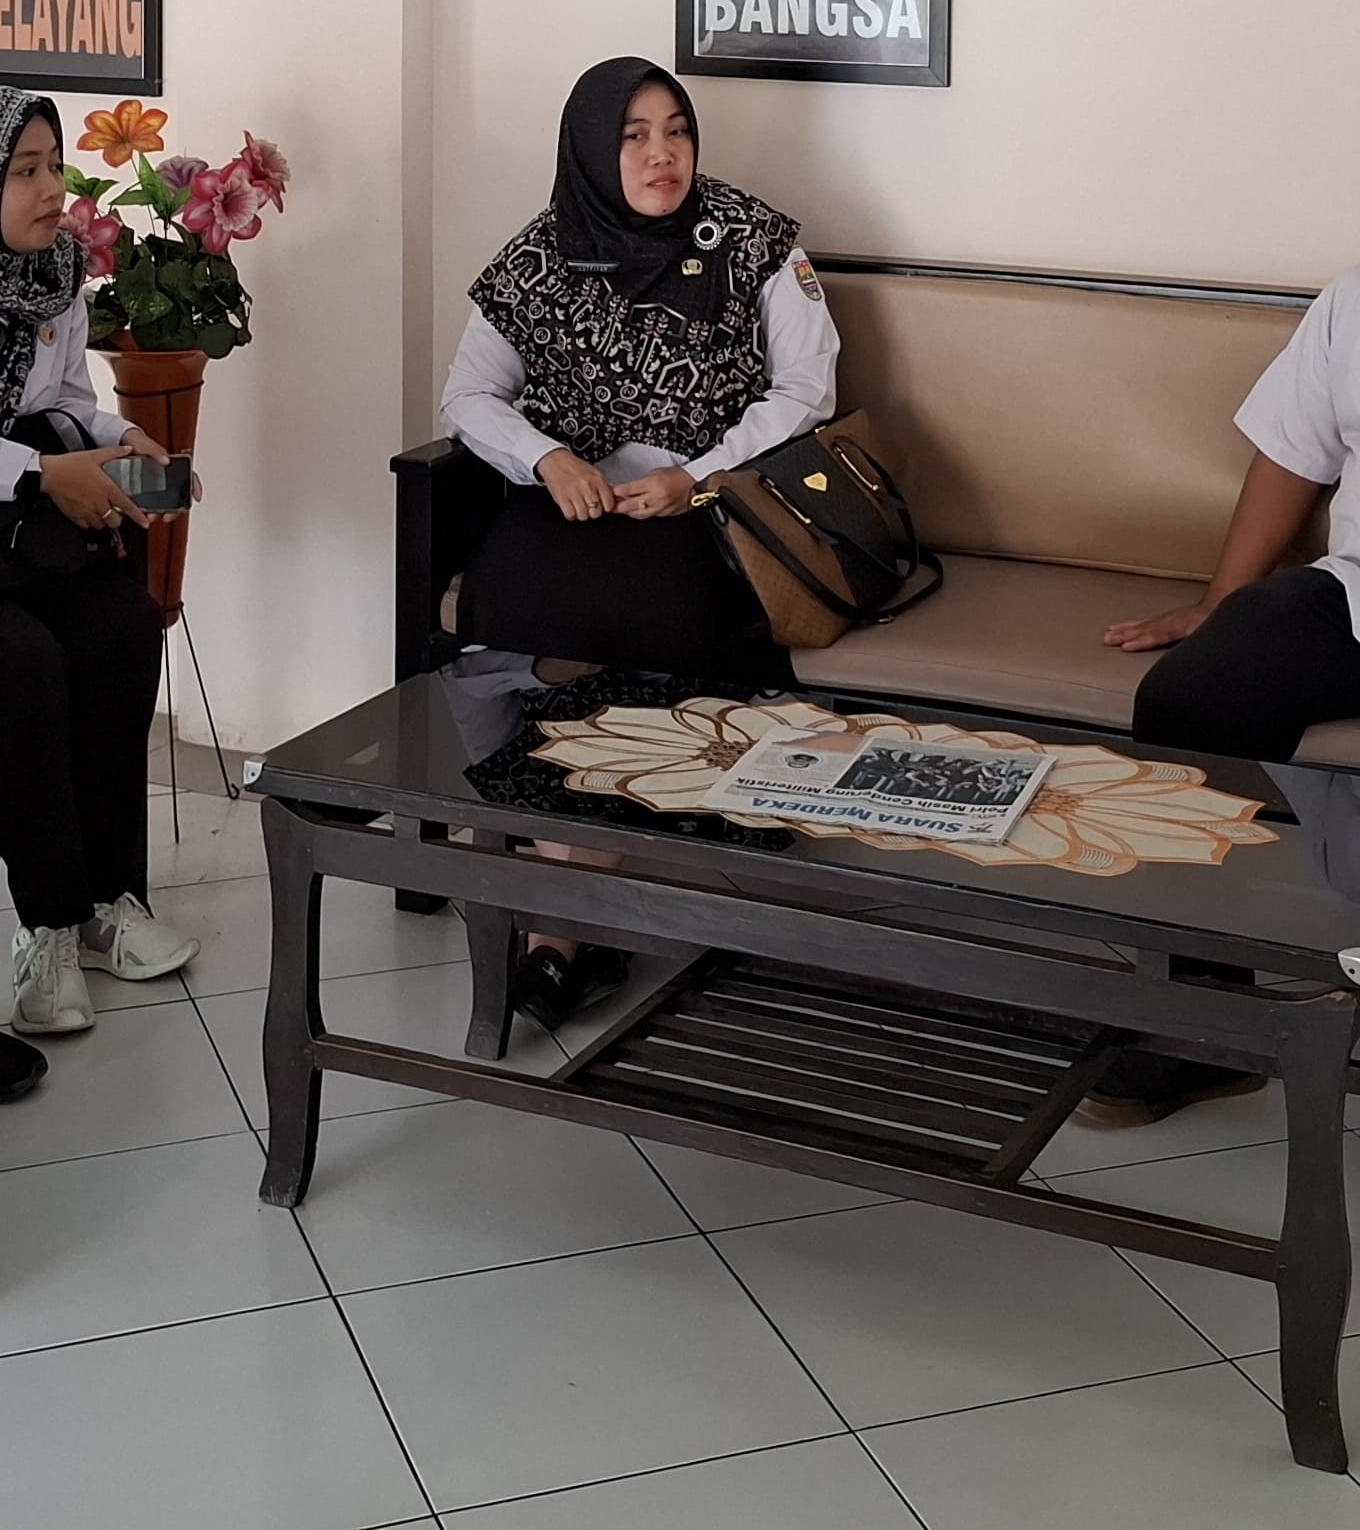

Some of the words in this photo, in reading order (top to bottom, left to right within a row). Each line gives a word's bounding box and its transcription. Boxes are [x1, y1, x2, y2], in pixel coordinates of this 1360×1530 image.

[736, 776, 821, 797] Militeristik
[823, 786, 914, 807] Cenderung
[751, 796, 875, 820] MERDEKA
[917, 800, 966, 815] Masih
[969, 805, 1008, 816] Polri
[878, 811, 963, 833] SUARA
